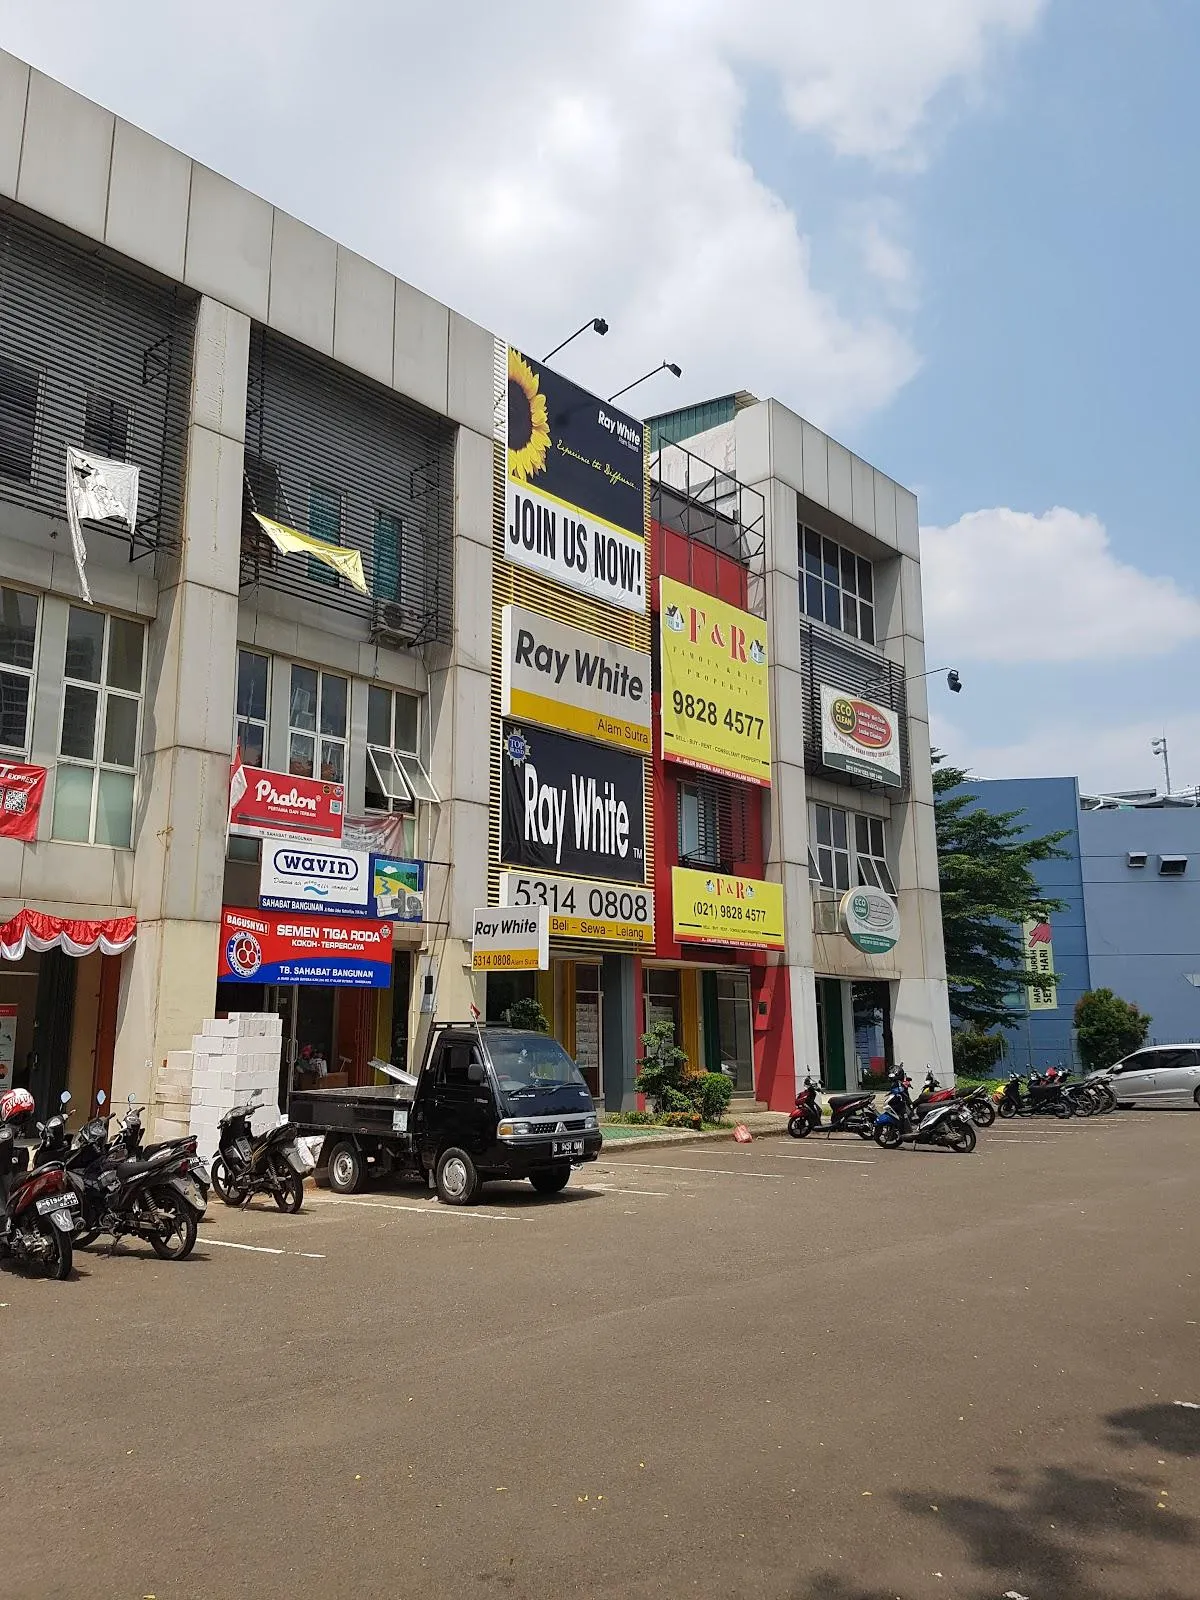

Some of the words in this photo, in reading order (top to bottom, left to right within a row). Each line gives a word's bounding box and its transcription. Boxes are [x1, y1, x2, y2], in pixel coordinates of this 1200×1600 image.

[598, 410, 616, 433] Ray
[616, 420, 640, 445] White
[556, 439, 590, 465] Experience
[592, 459, 602, 471] the
[509, 494, 556, 560] JOIN
[563, 517, 587, 574] US
[594, 531, 641, 595] NOW!
[689, 606, 706, 644] F
[710, 623, 726, 649] &
[729, 624, 748, 665] R
[515, 629, 570, 684] Ray
[575, 649, 643, 701] White
[672, 690, 718, 726] 9828
[724, 708, 764, 740] 4577
[836, 702, 852, 716] ECO
[836, 714, 852, 726] CLEAN
[598, 718, 622, 737] Alam
[624, 726, 648, 744] Sutra
[510, 739, 525, 750] TOP
[7, 772, 38, 784] EXPRESS
[255, 779, 316, 811] Pralon
[524, 762, 567, 865] Ray
[571, 773, 630, 858] White
[284, 855, 350, 876] wavin
[716, 878, 724, 896] F
[726, 882, 734, 894] &
[736, 881, 745, 900] R
[262, 898, 290, 910] SAHABAT
[292, 901, 324, 912] BANGUNAN
[514, 880, 576, 914] 5314
[588, 888, 648, 922] 0808
[855, 898, 865, 906] ECO
[693, 902, 718, 920] (021)
[720, 904, 742, 920] 9828
[745, 908, 766, 922] 4577
[226, 914, 268, 934] BAGUSNYA!
[276, 924, 320, 938] SEMEN
[322, 928, 348, 940] TIGA
[350, 930, 380, 942] RODA
[474, 920, 499, 938] Ray
[501, 918, 537, 934] White
[552, 918, 570, 931] Beli
[580, 921, 606, 936] Sewa
[616, 924, 644, 941] Lelang
[292, 940, 318, 948] KOKOH
[321, 941, 364, 950] TERPERCAYA
[473, 954, 491, 966] 5314
[492, 954, 511, 966] 0808
[1040, 950, 1049, 971] HARI
[280, 966, 292, 974] TB.
[294, 966, 331, 976] SAHABAT
[332, 970, 374, 978] BANGUNAN
